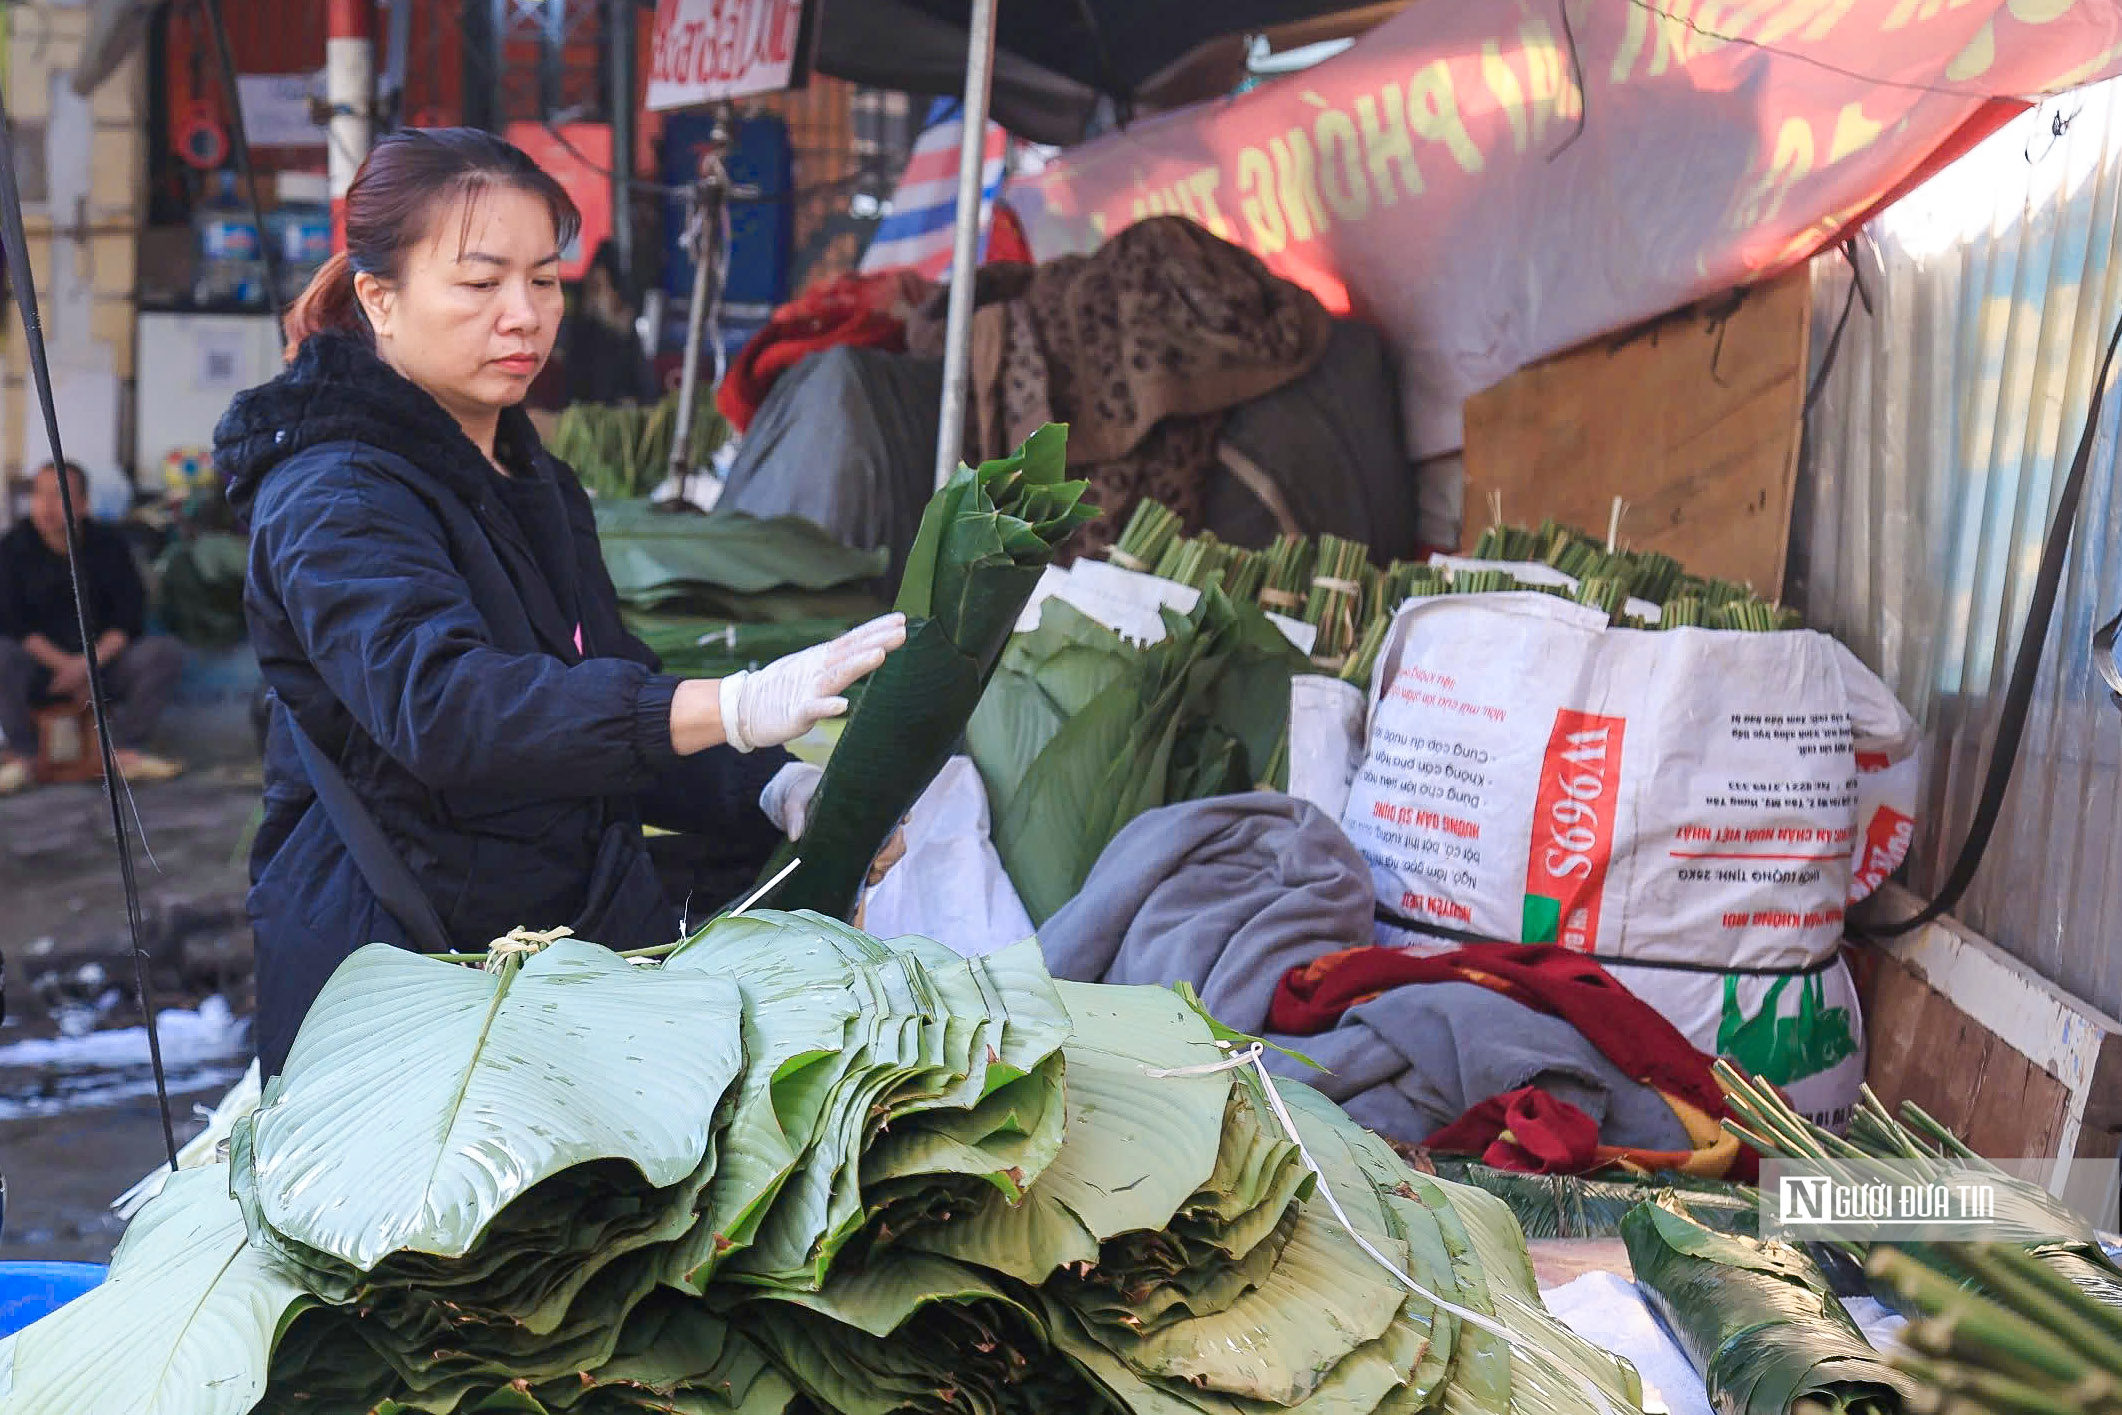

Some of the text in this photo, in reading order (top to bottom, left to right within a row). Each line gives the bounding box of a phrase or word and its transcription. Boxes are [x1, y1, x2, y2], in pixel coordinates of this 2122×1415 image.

[1453, 743, 1489, 766] Cung
[1445, 765, 1485, 788] Không
[1419, 784, 1444, 802] cho
[1546, 727, 1611, 880] W969S
